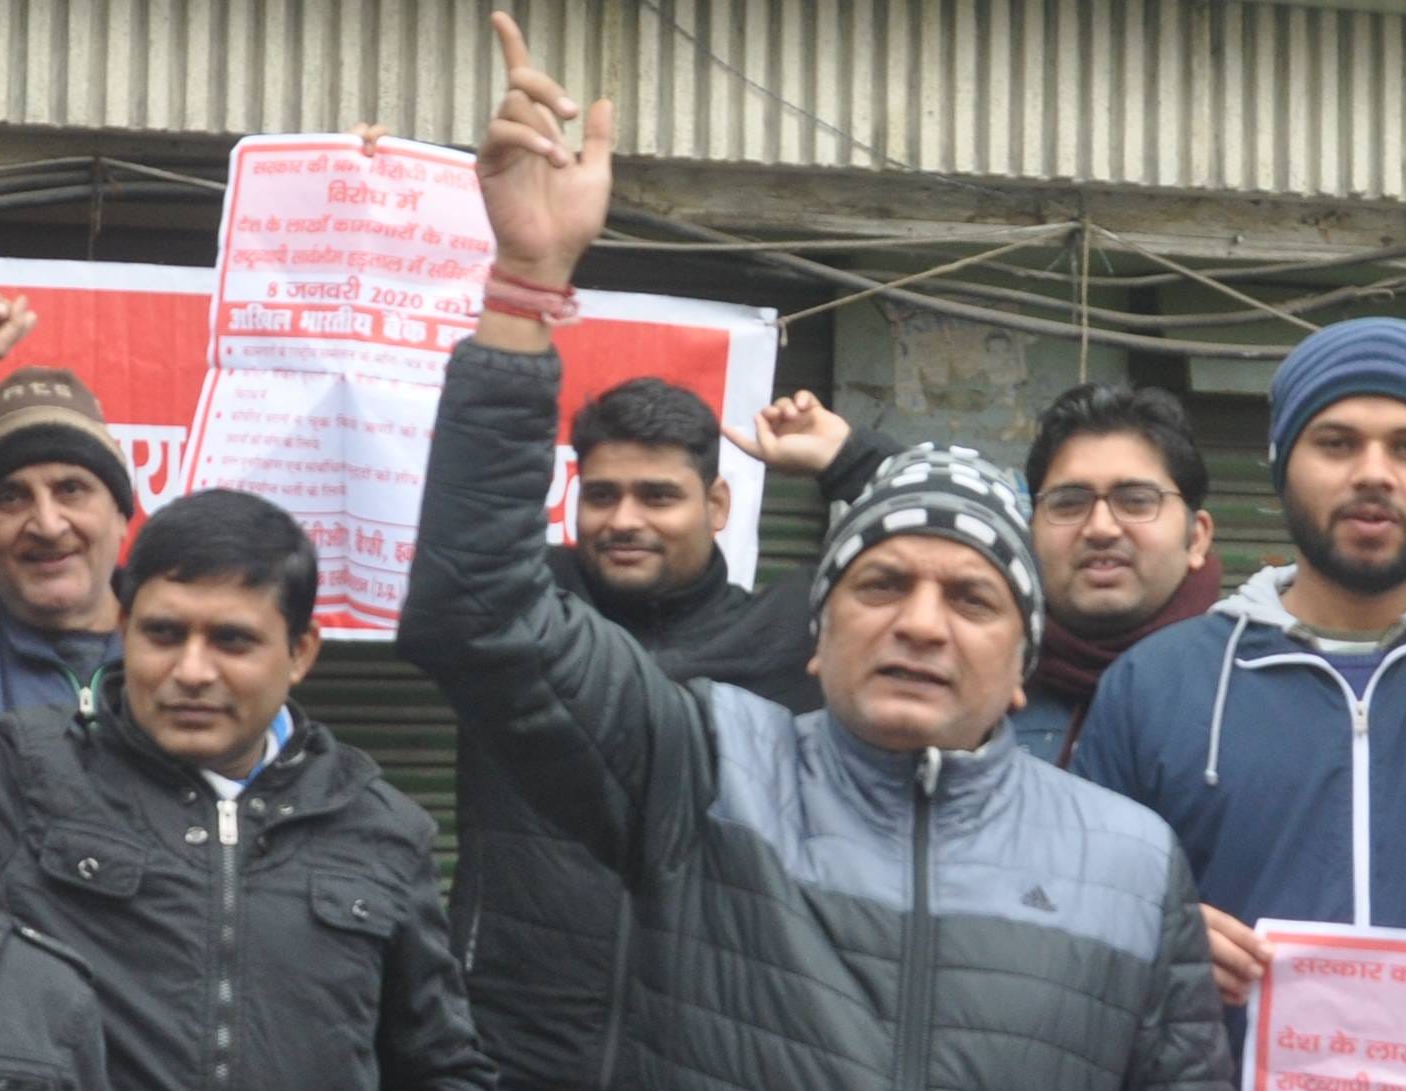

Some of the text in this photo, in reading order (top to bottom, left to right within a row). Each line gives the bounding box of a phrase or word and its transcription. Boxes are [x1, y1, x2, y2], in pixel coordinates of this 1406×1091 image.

[286, 275, 361, 302] जनवरी
[370, 286, 424, 309] 2020
[1291, 958, 1384, 981] सरकार
[1276, 1025, 1321, 1053] देश
[1329, 1030, 1357, 1054] के
